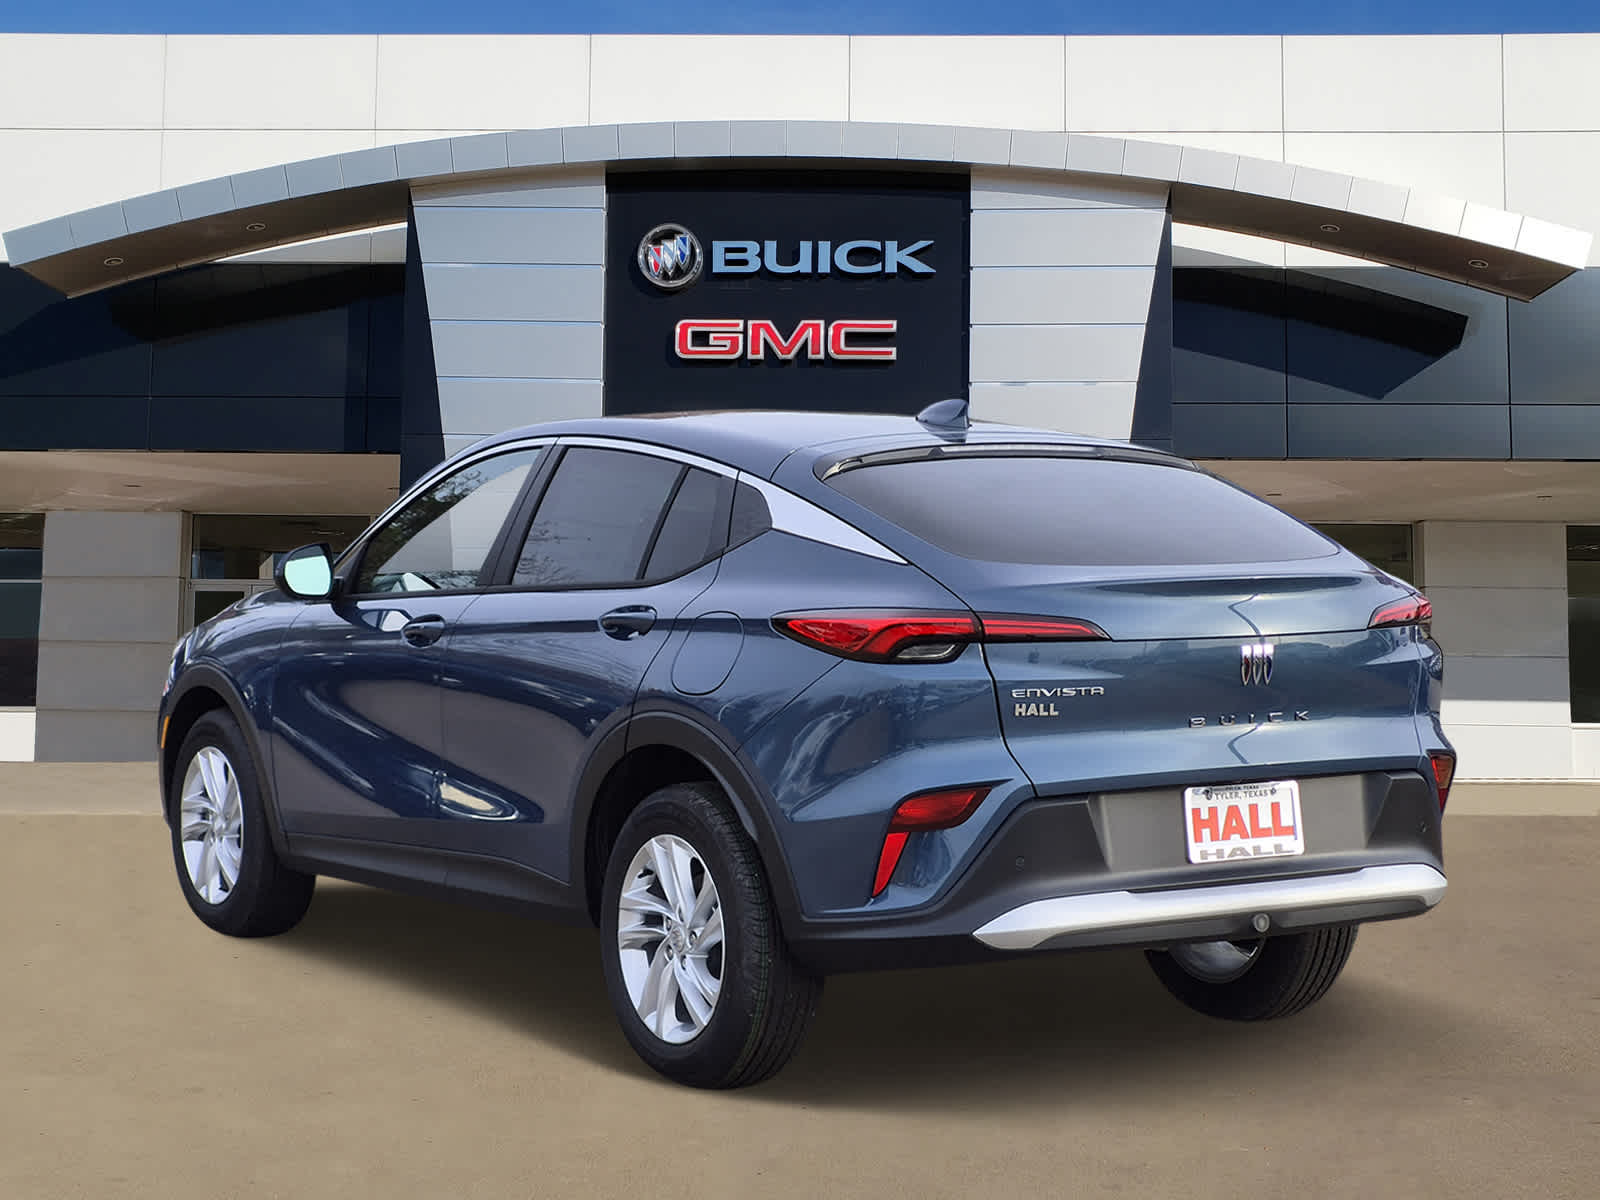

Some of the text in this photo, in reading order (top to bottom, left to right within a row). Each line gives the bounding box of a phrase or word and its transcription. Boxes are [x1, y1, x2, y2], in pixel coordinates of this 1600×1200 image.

[712, 240, 937, 273] BUICK
[675, 319, 897, 360] GMC
[1011, 686, 1105, 698] ENVISTA
[1014, 703, 1059, 717] HALL
[1190, 710, 1310, 728] BUICK
[1244, 788, 1268, 798] TEXAS
[1192, 801, 1295, 843] HALL
[1199, 843, 1295, 860] HALL
